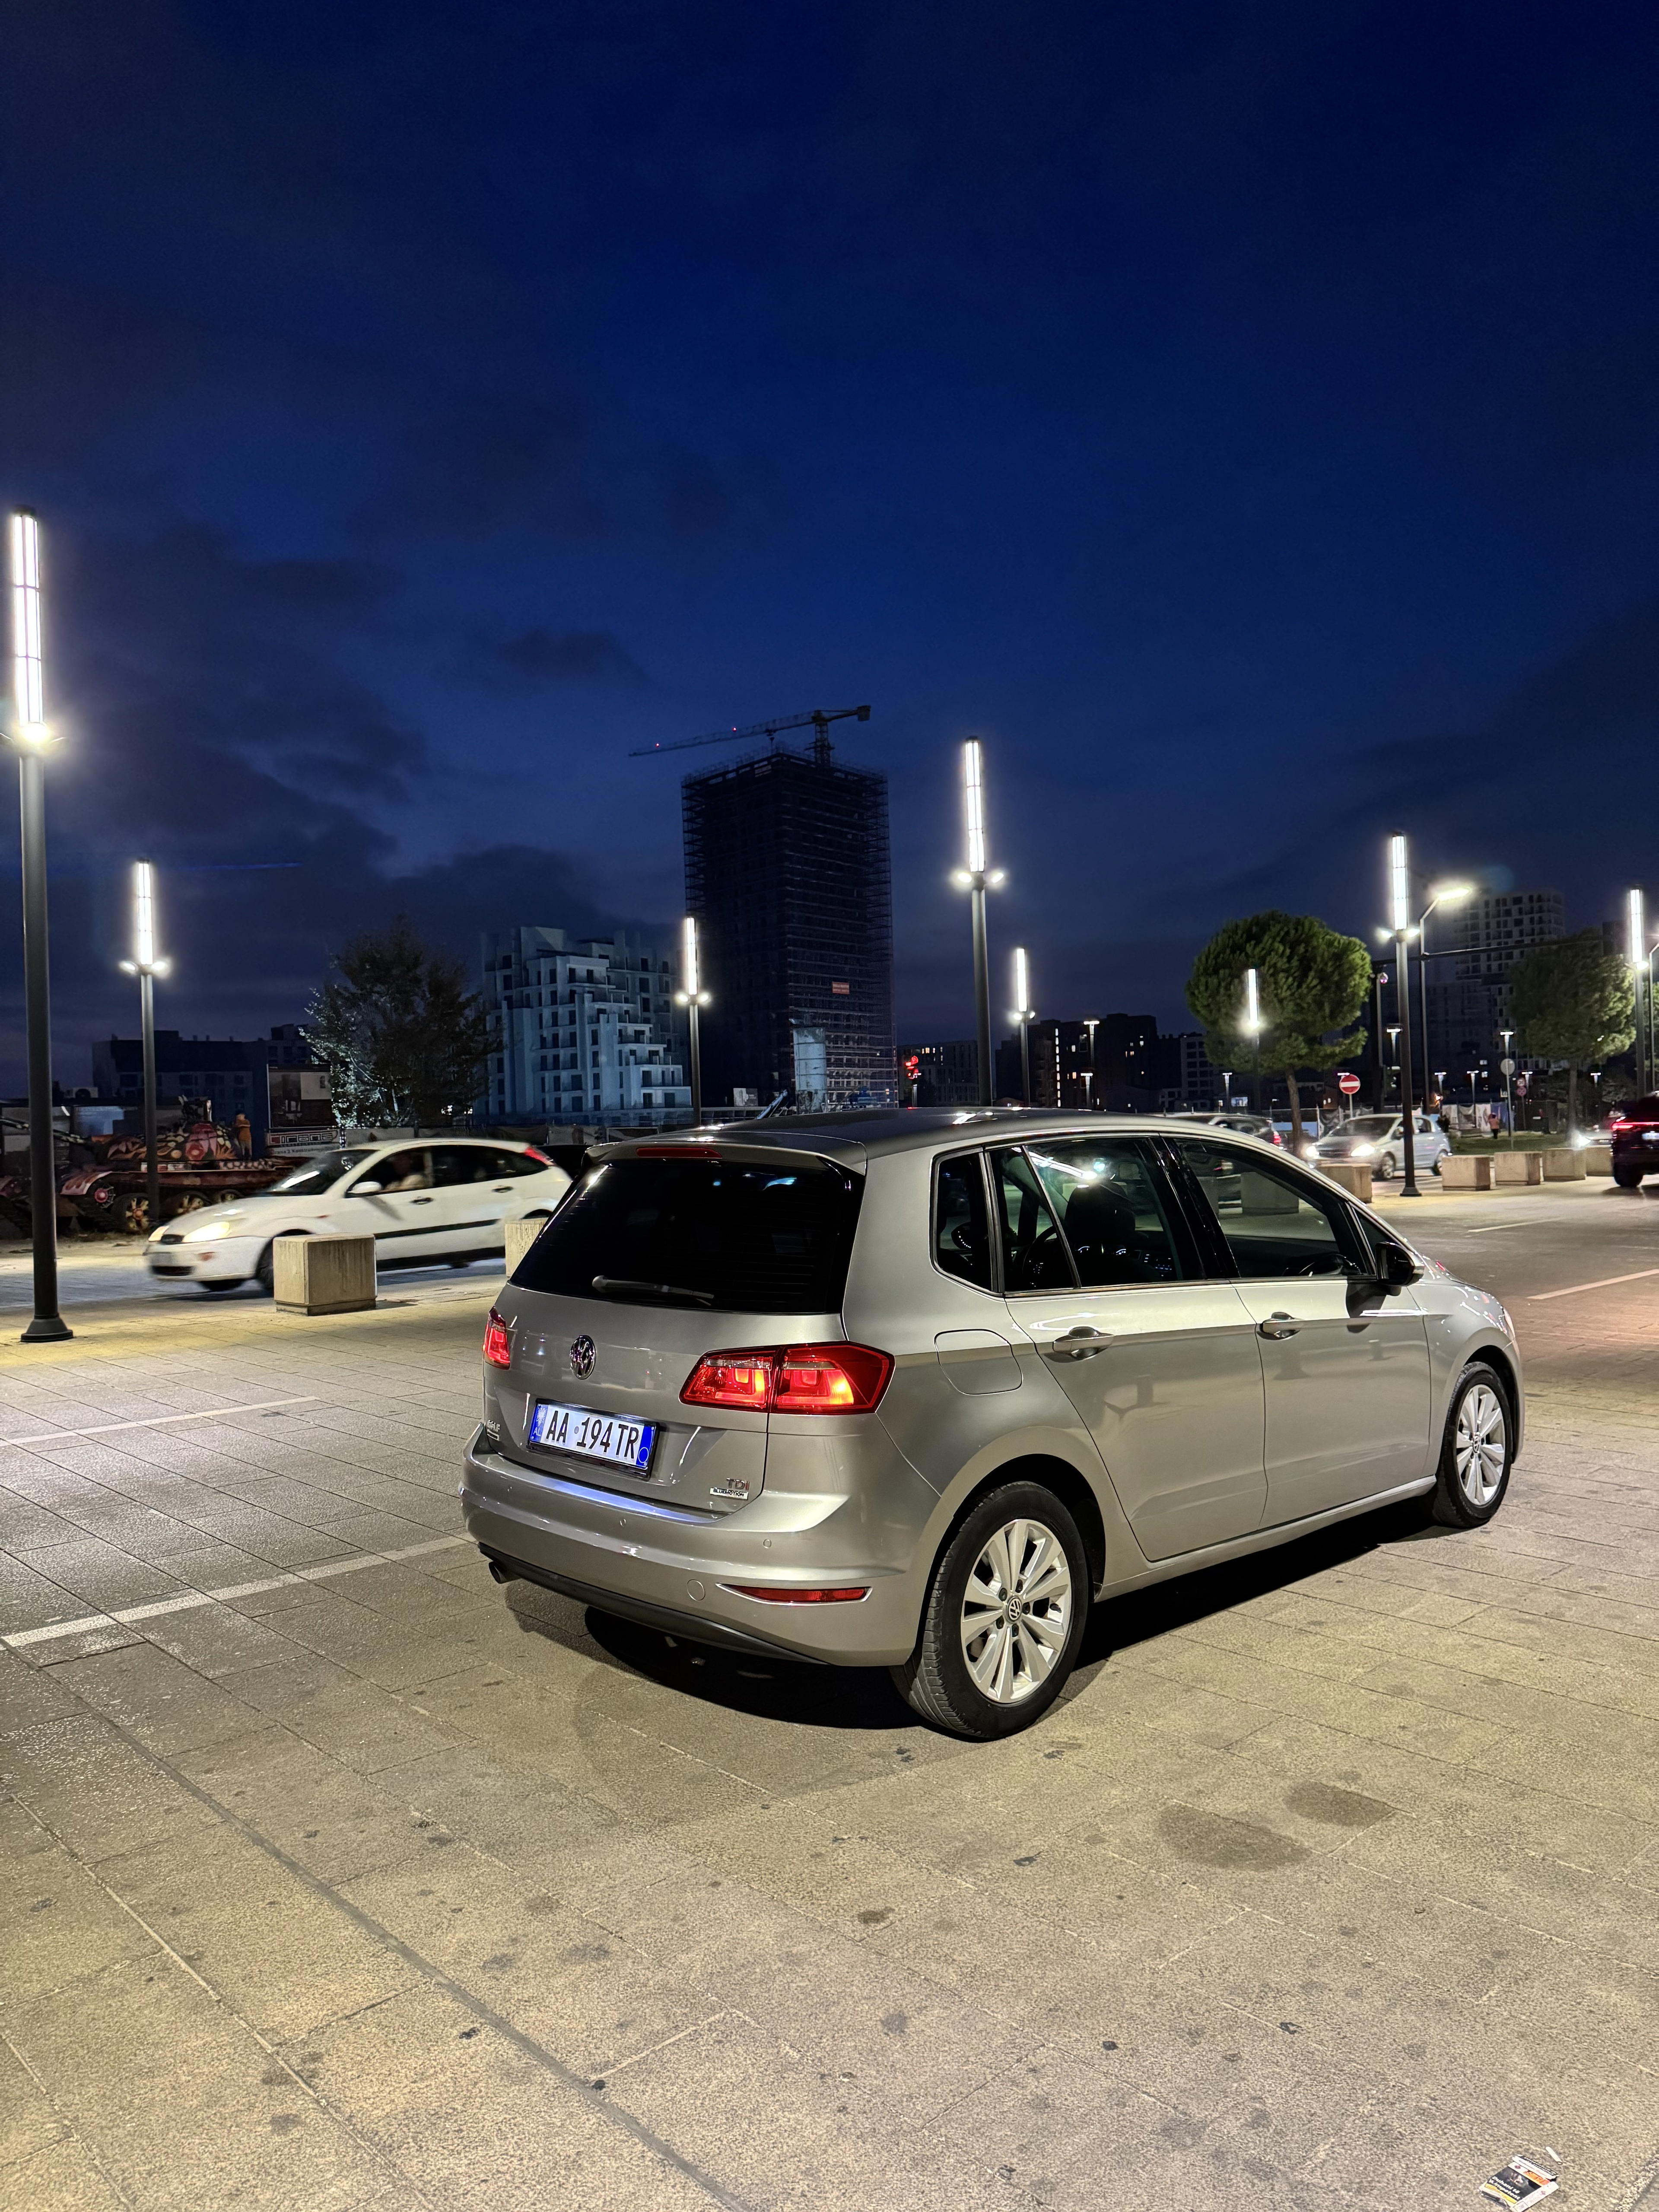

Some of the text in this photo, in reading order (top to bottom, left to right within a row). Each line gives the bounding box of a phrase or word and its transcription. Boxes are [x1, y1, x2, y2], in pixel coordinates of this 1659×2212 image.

[533, 1427, 541, 1436] AL
[546, 1411, 569, 1443] AA
[727, 1478, 750, 1491] TDI
[713, 1488, 744, 1497] BLUEMOTION
